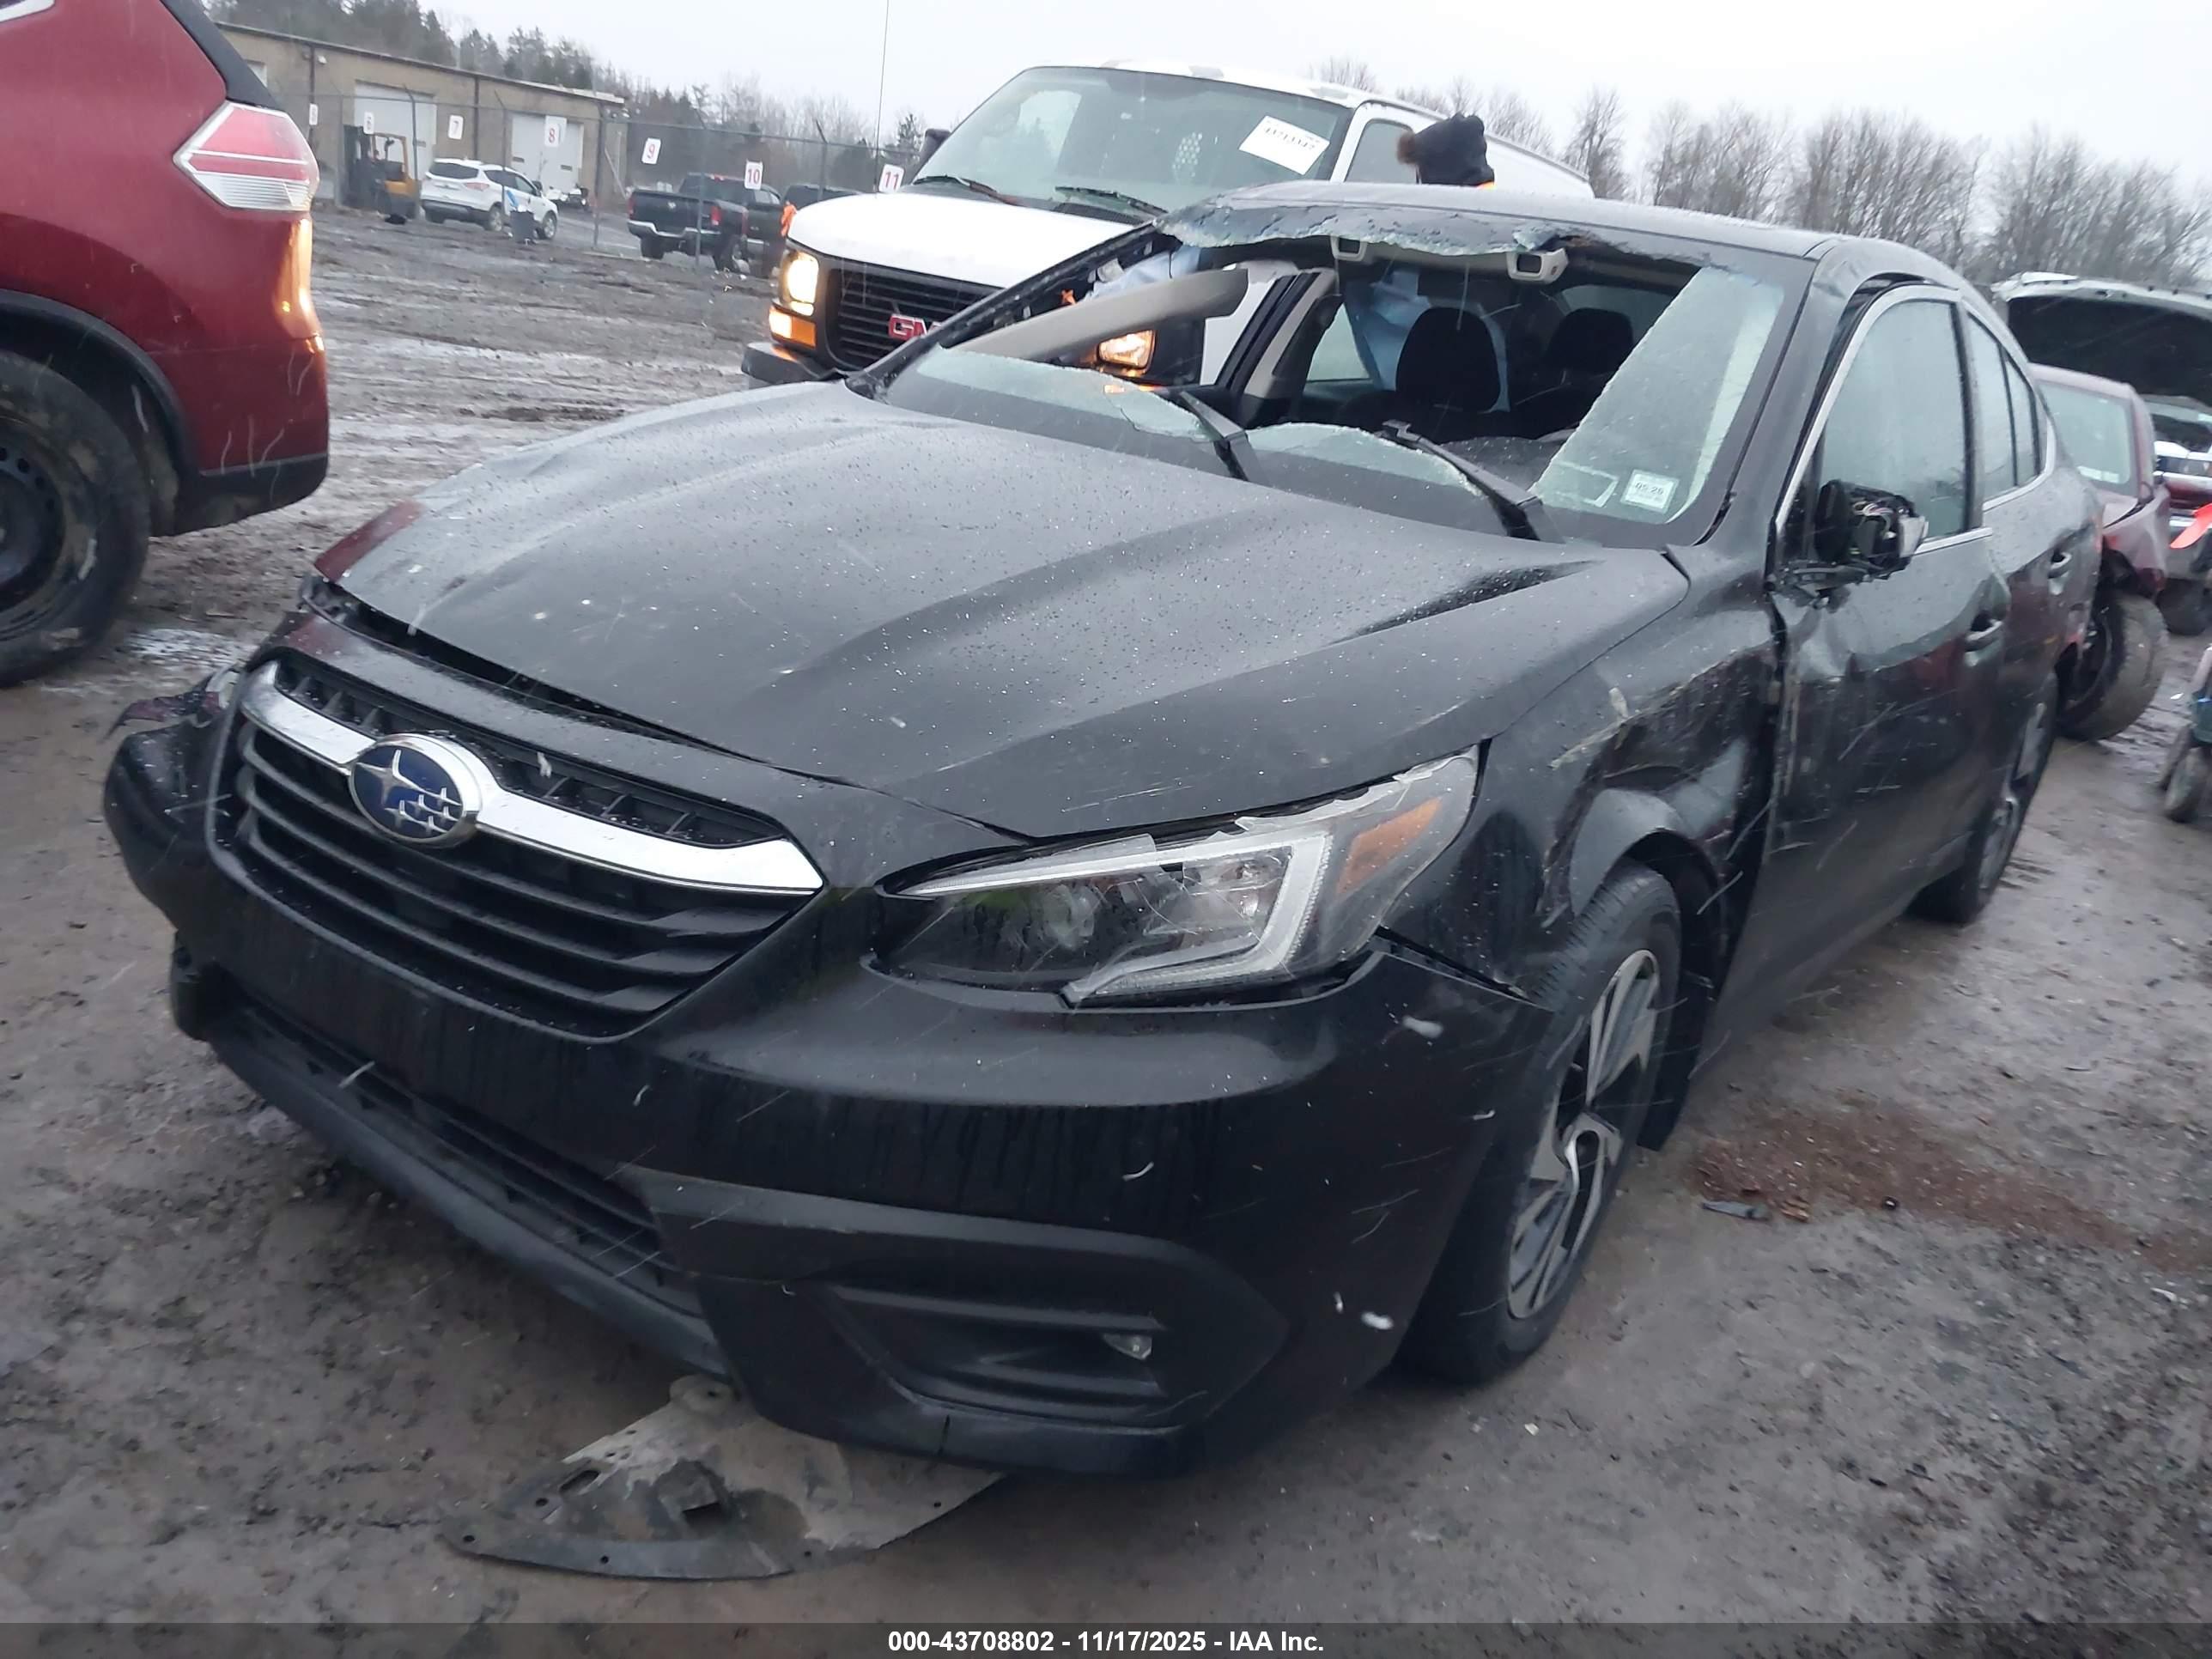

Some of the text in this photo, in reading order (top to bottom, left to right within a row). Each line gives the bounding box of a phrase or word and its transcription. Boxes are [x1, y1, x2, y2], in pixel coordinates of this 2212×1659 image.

[549, 128, 556, 143] 8
[647, 143, 656, 159] 9
[747, 168, 760, 184] 10
[885, 172, 899, 190] 11
[888, 313, 943, 341] GM
